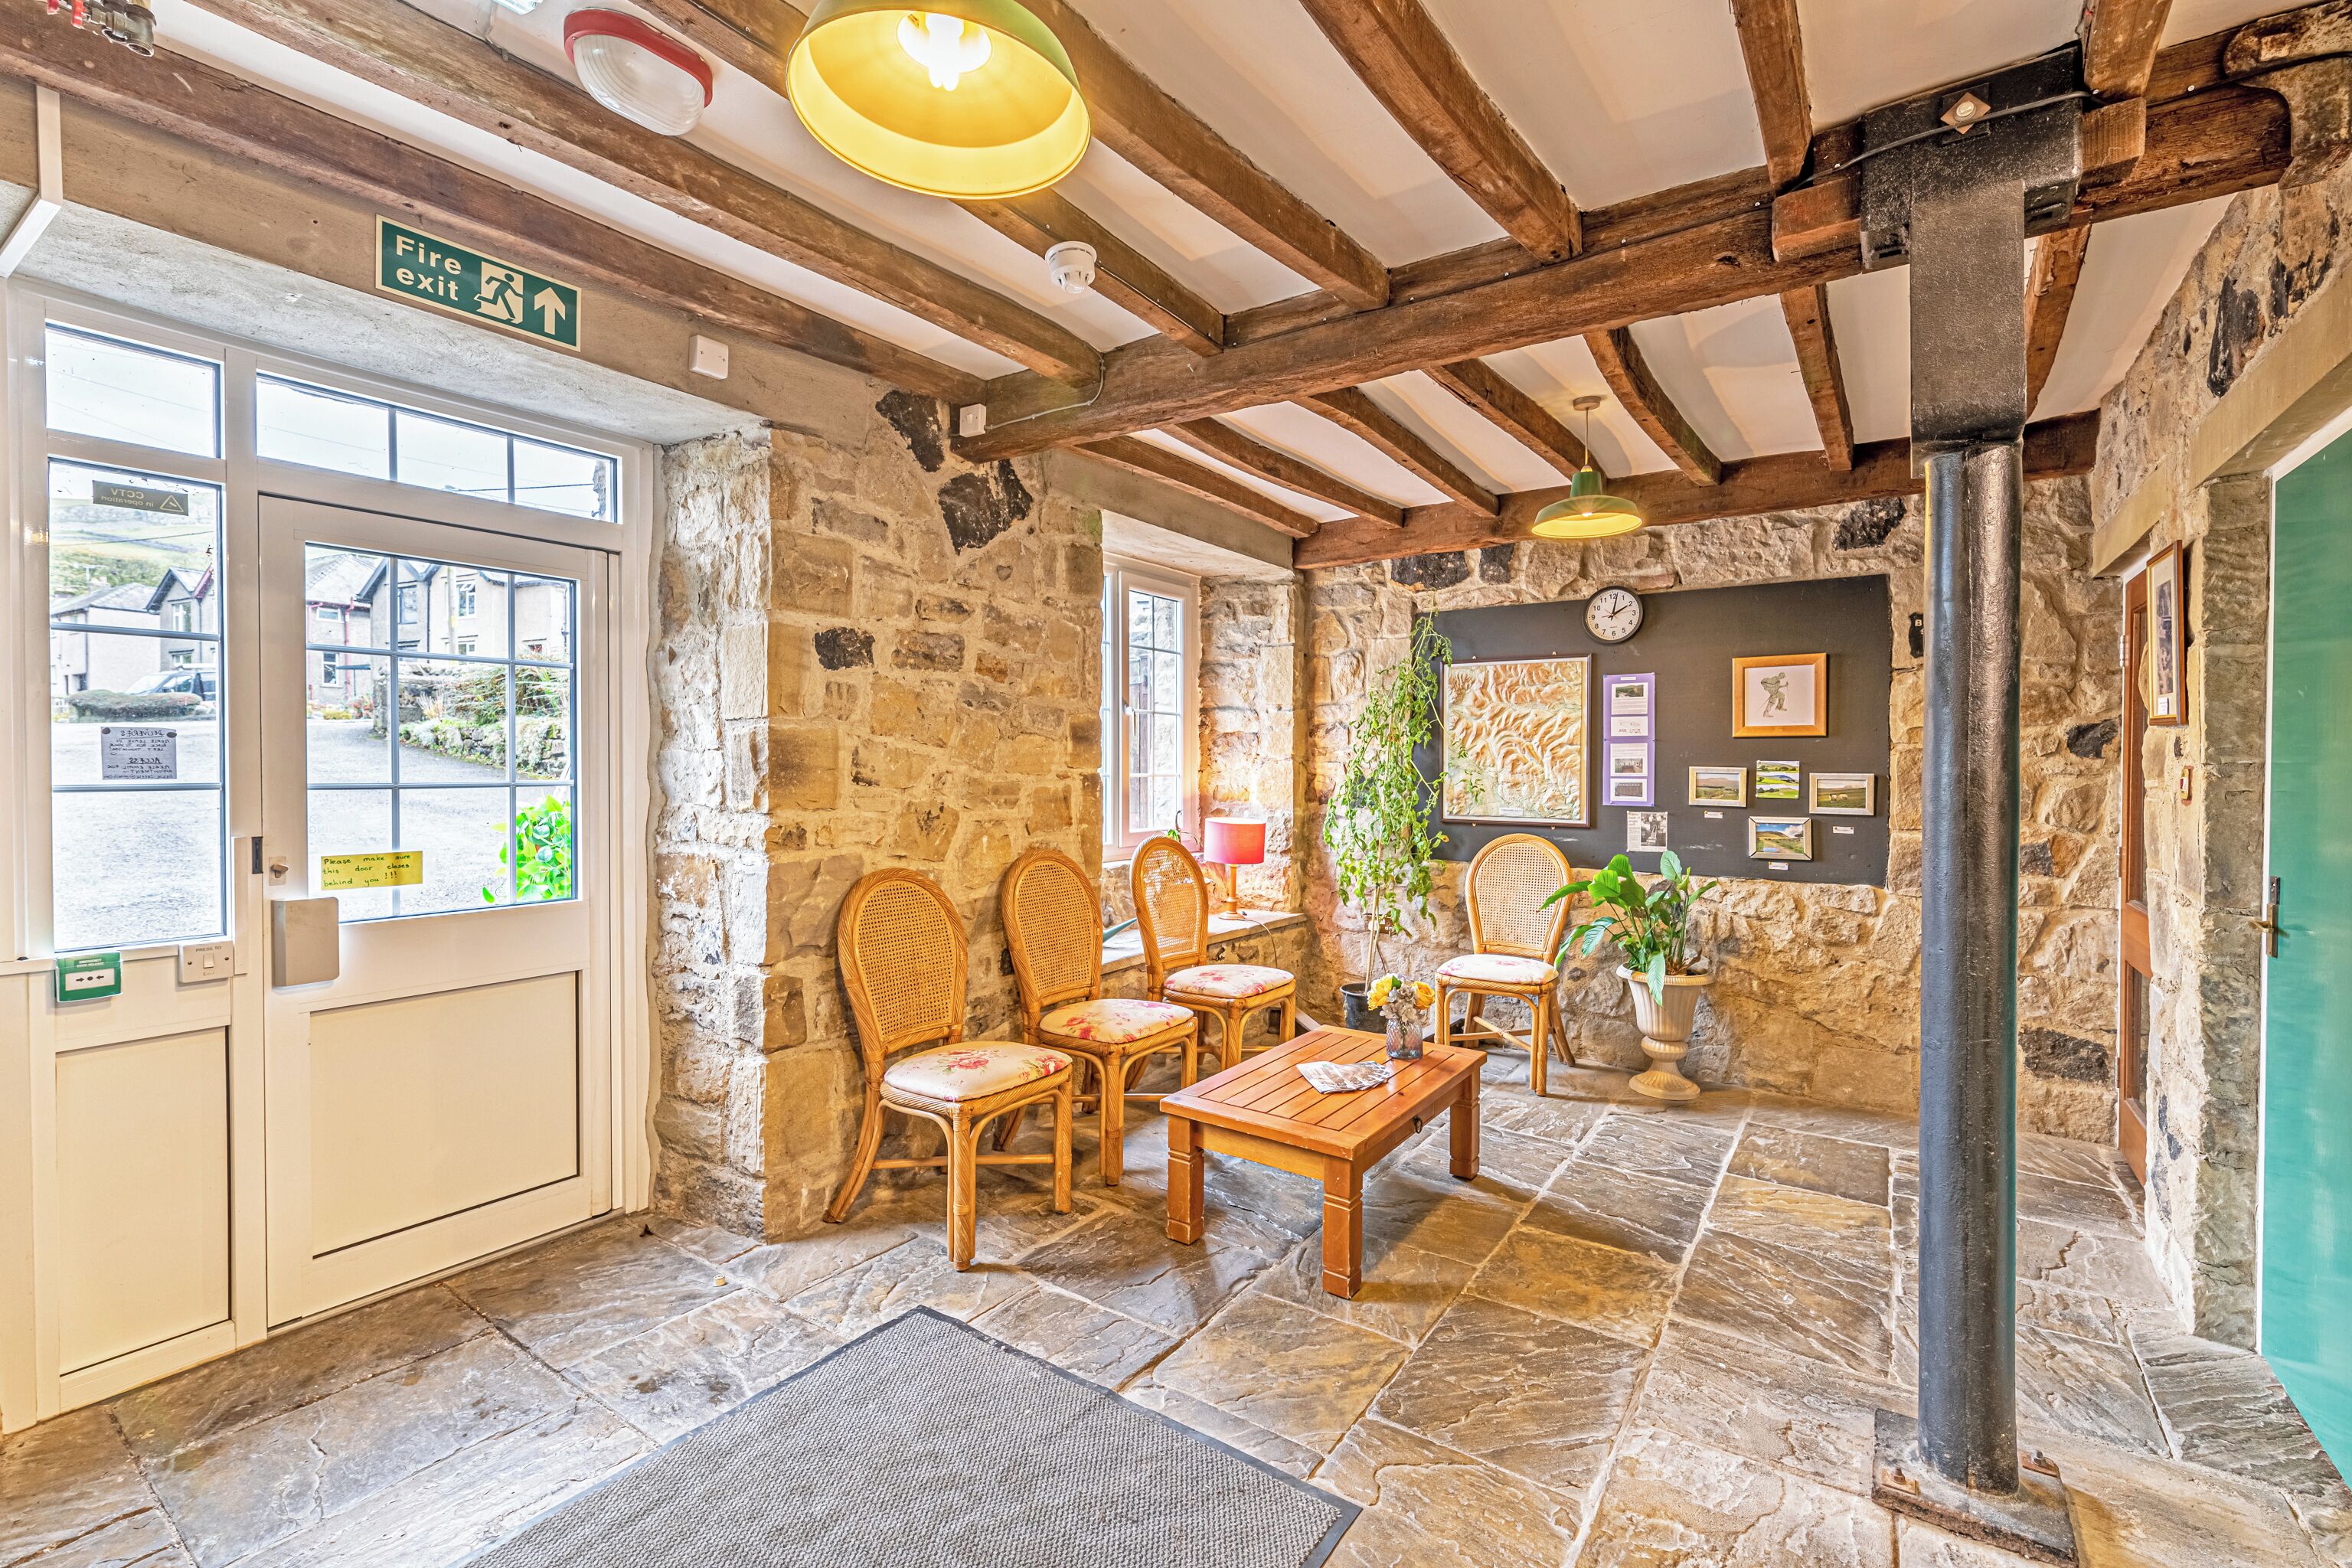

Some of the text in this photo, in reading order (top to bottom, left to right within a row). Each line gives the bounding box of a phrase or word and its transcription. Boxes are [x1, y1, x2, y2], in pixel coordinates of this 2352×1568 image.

[396, 234, 462, 275] Fire
[396, 267, 459, 301] exit
[324, 878, 353, 887] behind
[364, 878, 380, 887] you
